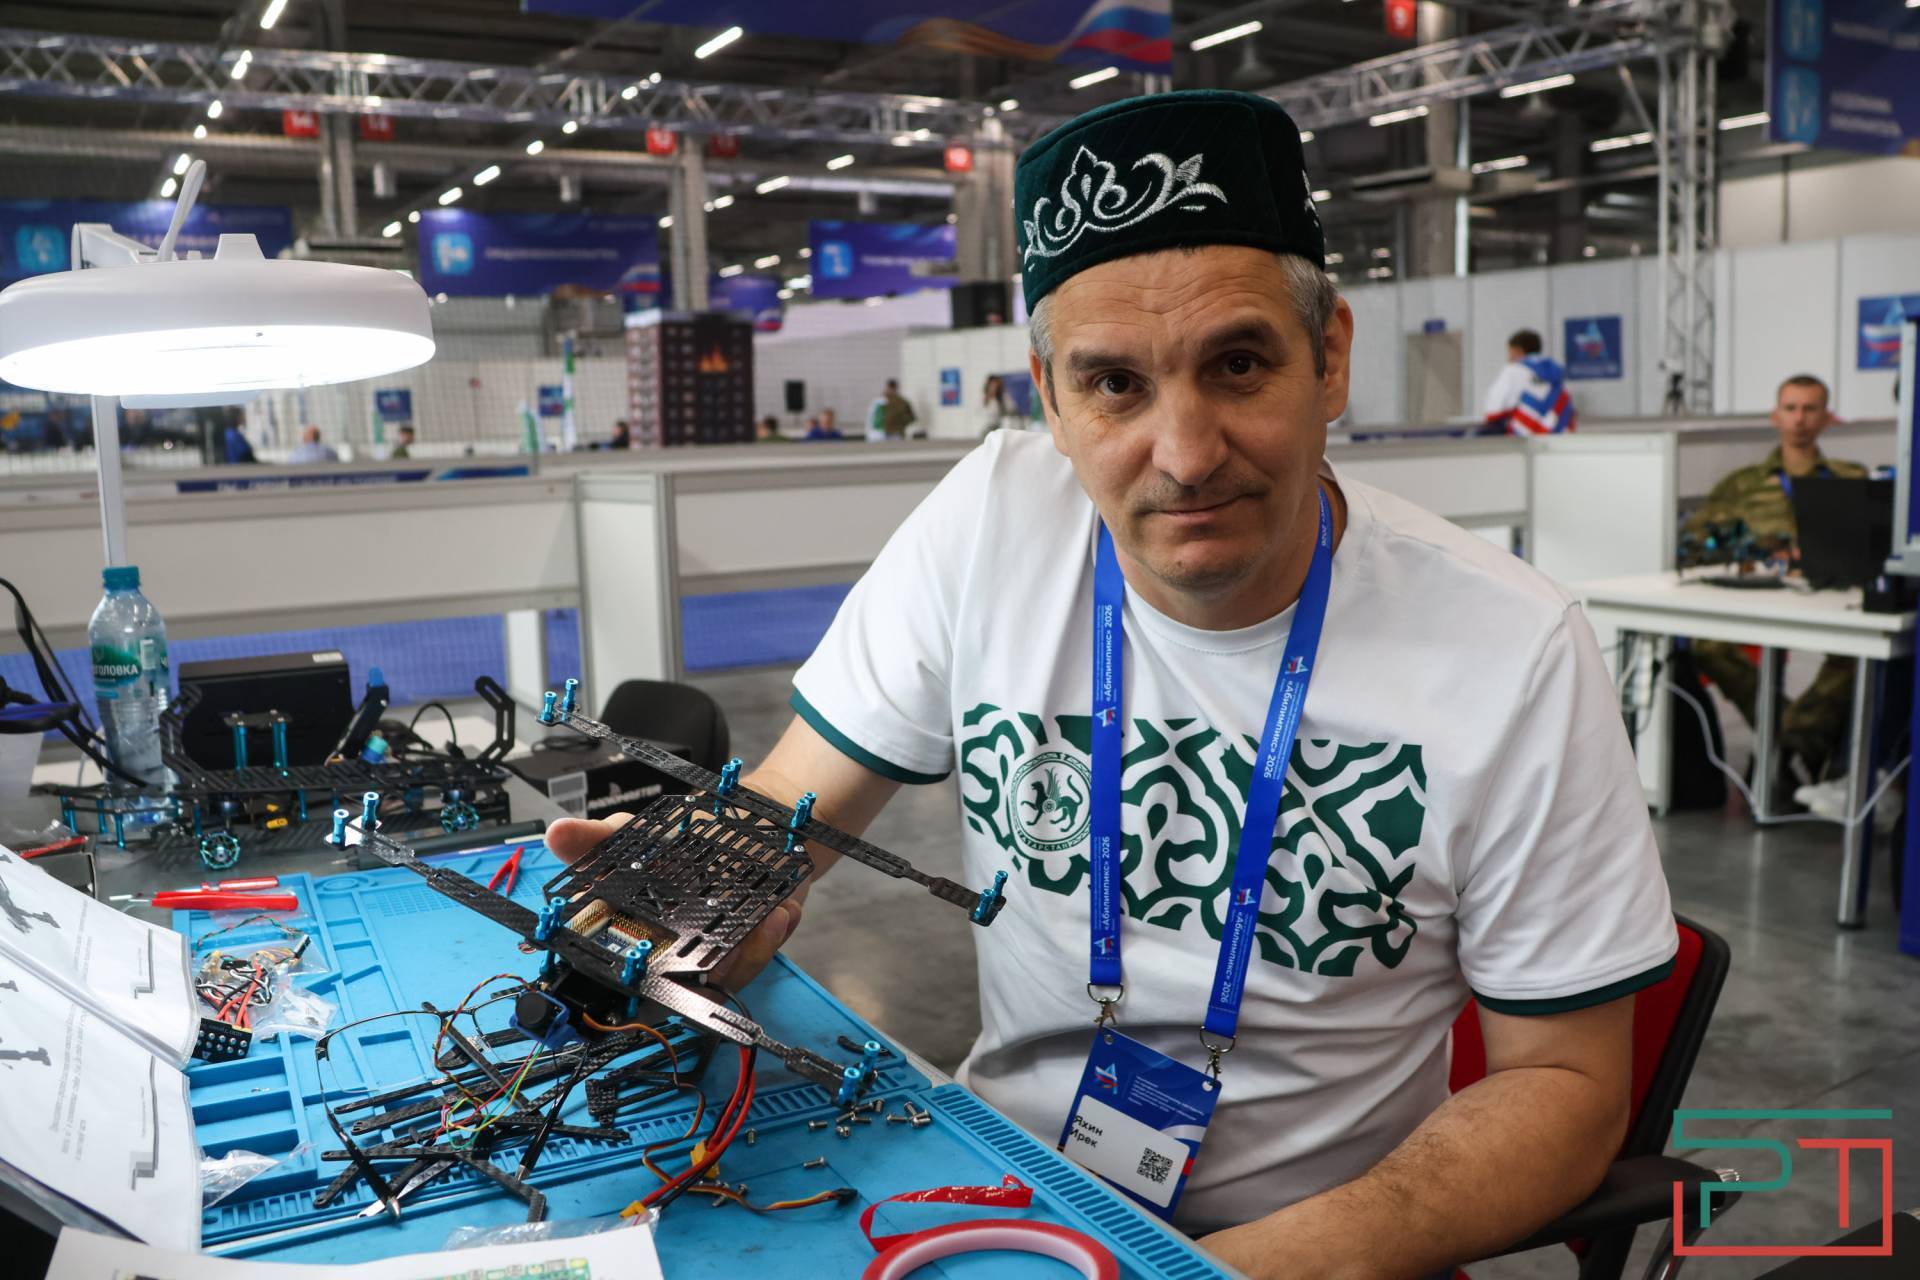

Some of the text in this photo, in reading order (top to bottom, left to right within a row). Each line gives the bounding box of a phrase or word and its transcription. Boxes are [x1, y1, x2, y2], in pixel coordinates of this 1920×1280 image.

[1103, 604, 1112, 702] «Абилимпикс» 2026
[1270, 681, 1294, 753] «Абилимпикс»
[1263, 754, 1276, 779] 2026
[1102, 836, 1110, 931] «Абилимпикс» 2026
[1225, 911, 1244, 981] «Абилимпикс»
[1221, 981, 1233, 1004] 2026
[1070, 1126, 1098, 1149] Ирек
[1073, 1114, 1103, 1137] Яхин
